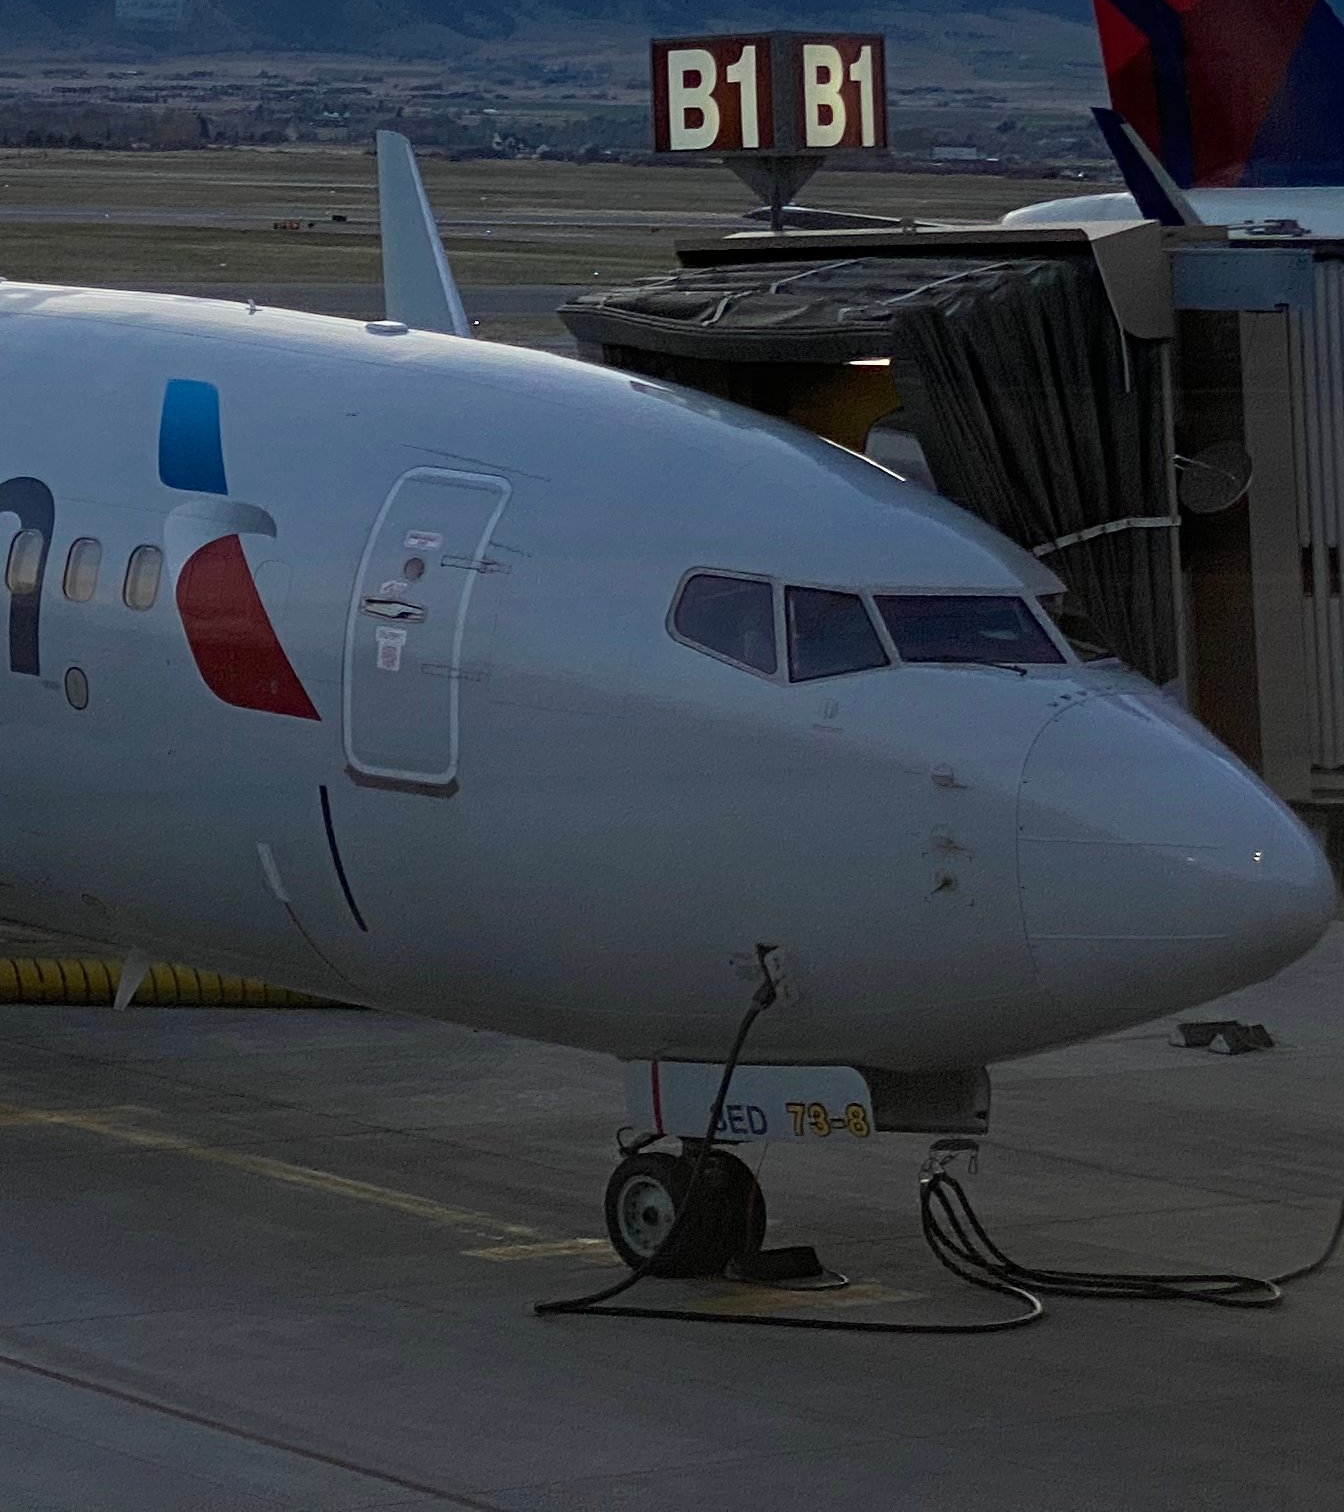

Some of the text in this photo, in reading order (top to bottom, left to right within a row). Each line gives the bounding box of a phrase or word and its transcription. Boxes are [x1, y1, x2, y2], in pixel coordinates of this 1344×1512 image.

[668, 45, 760, 150] B1
[803, 44, 875, 148] B1
[785, 1102, 870, 1138] 73-8
